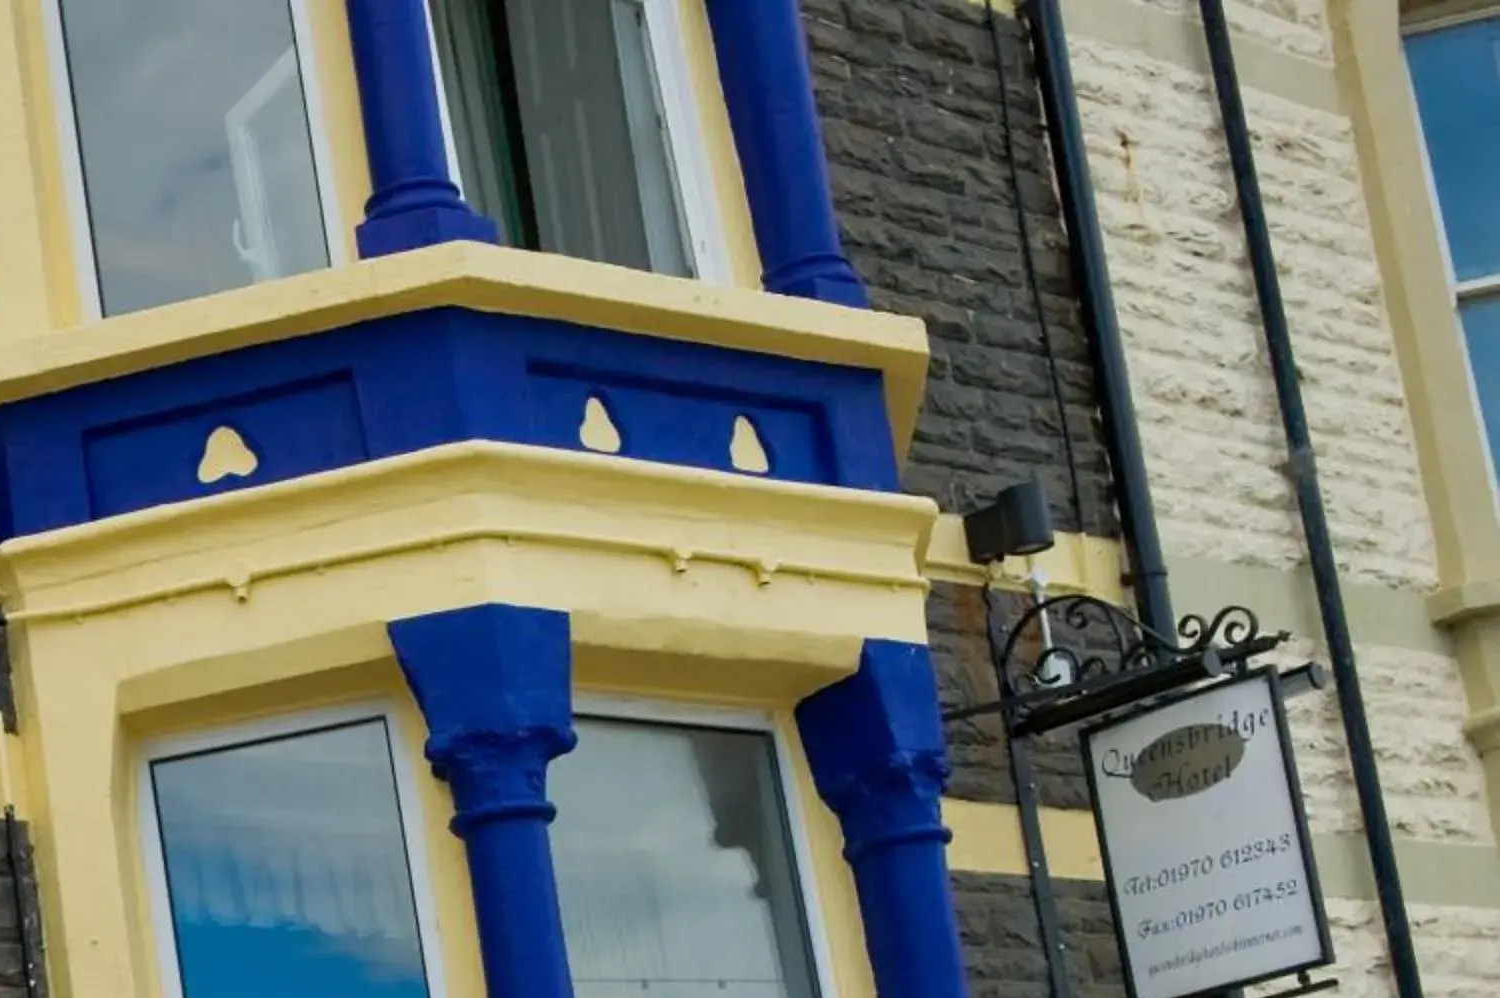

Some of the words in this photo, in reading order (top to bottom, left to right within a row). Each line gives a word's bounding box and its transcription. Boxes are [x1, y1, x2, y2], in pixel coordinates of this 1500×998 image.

[1102, 709, 1269, 778] Queensbridge
[1150, 755, 1231, 799] Hotel
[1219, 833, 1291, 869] 612343
[1233, 879, 1297, 912] 617452
